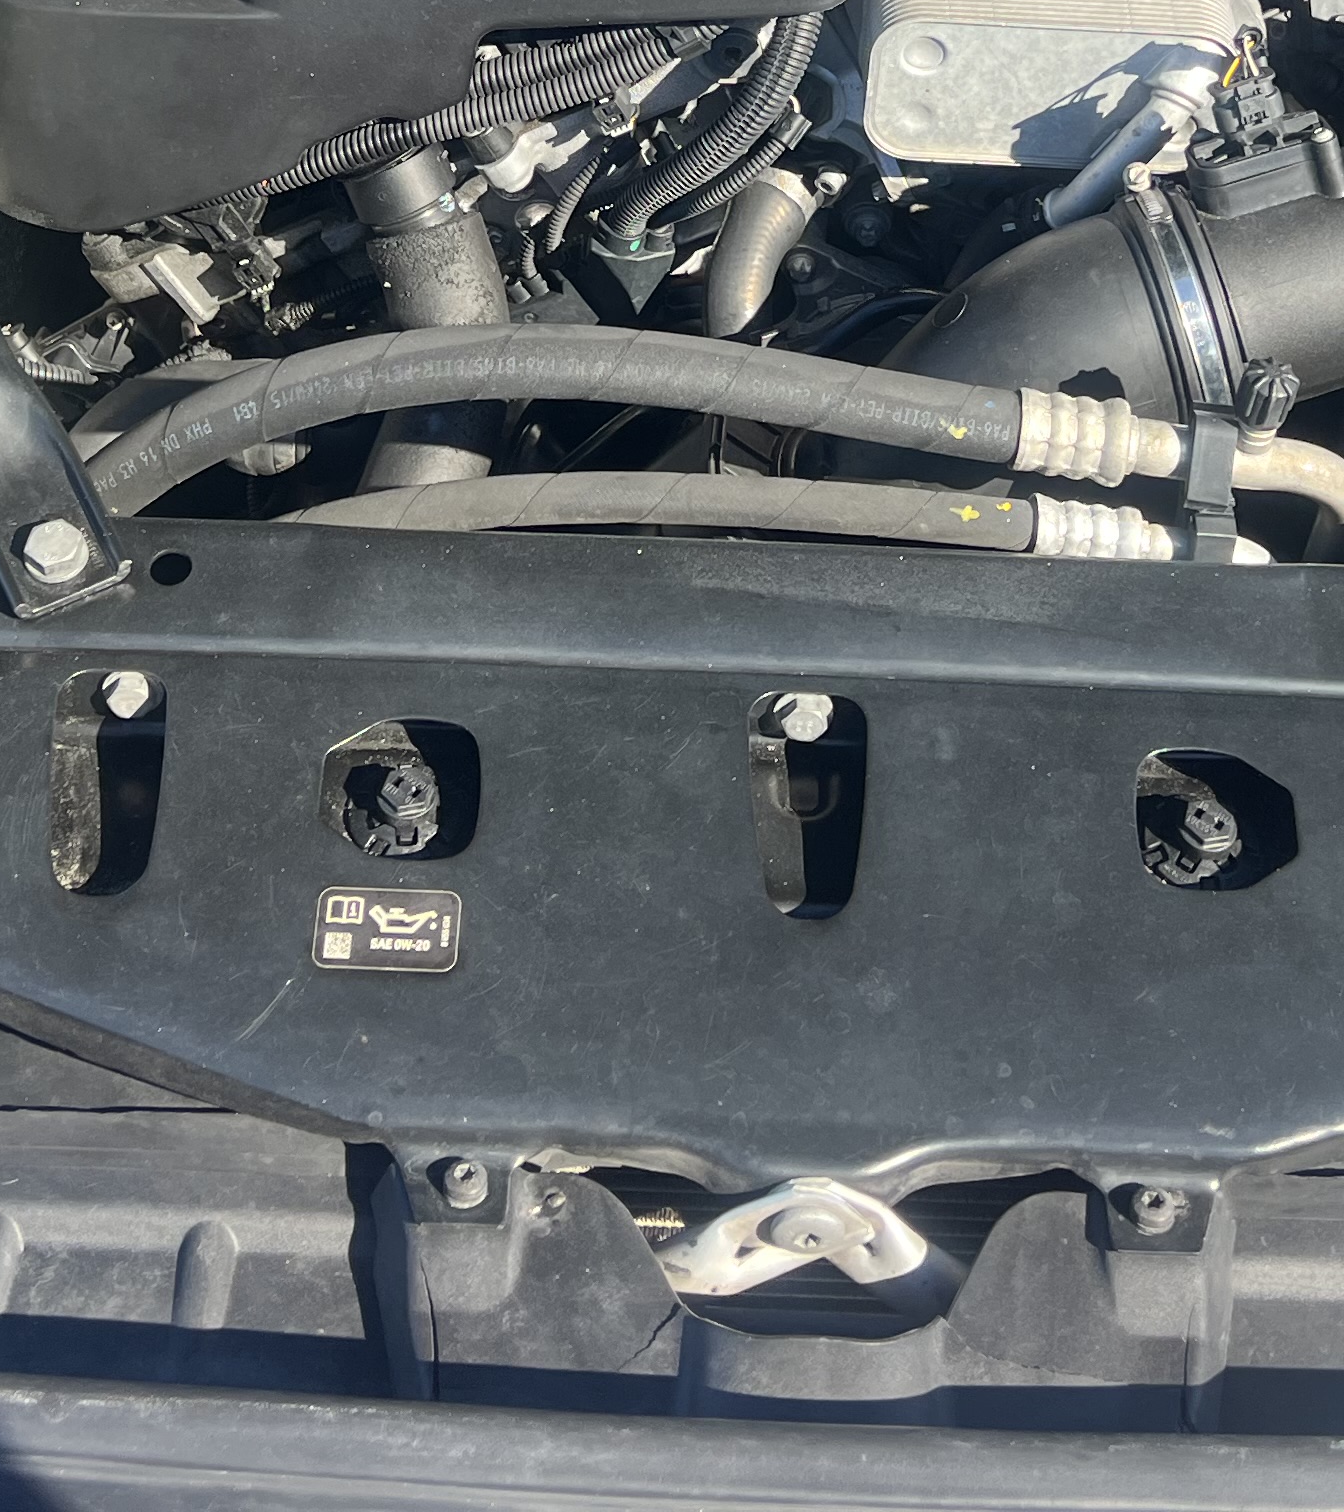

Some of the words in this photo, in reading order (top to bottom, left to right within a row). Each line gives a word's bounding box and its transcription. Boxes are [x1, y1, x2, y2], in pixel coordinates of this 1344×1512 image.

[184, 418, 213, 442] PHX
[369, 937, 393, 951] SAE
[394, 938, 431, 952] 0W-20
